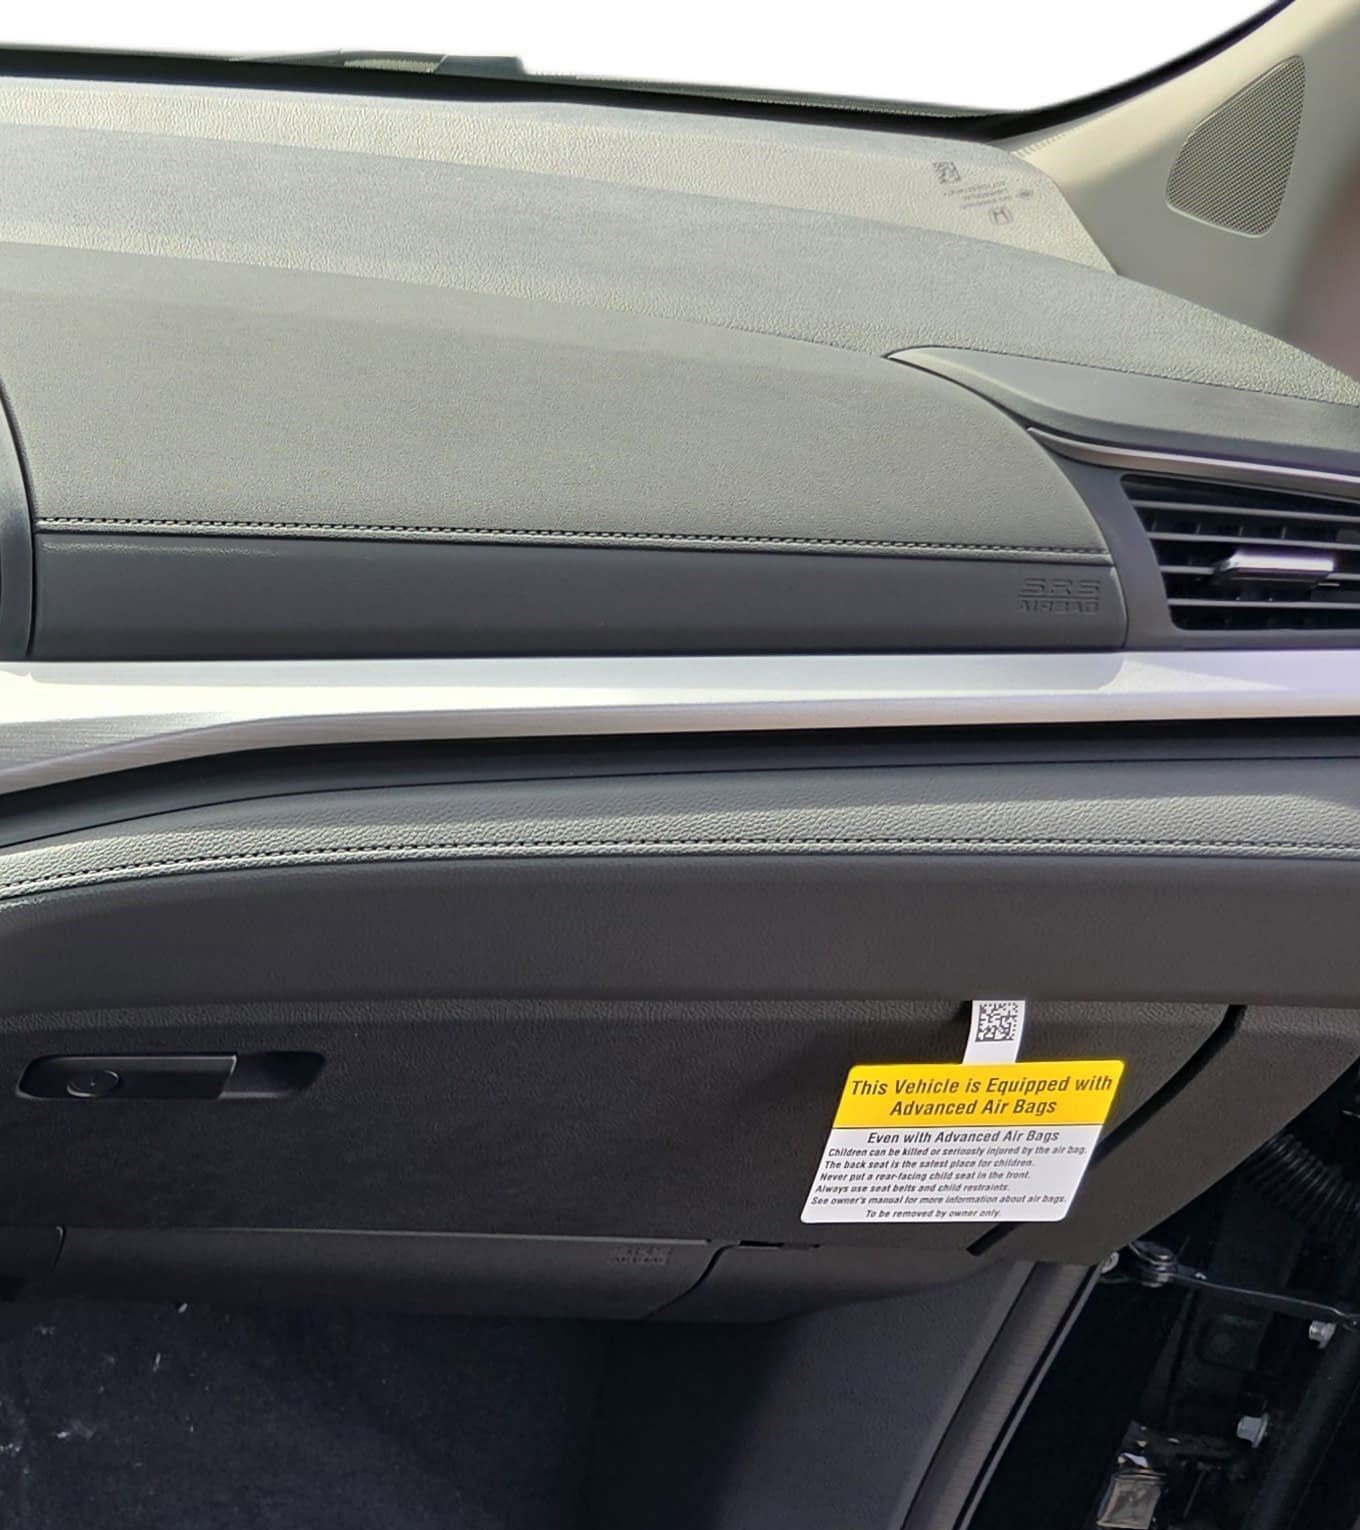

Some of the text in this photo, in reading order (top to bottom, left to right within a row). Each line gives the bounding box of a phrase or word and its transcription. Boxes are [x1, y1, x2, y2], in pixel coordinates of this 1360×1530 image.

[1020, 578, 1101, 595] SRS
[852, 1075, 1113, 1096] This Vehicle is Equipped with
[889, 1099, 1057, 1116] Advanced Air Bags
[867, 1130, 1060, 1143] Even with Advanced Air Bags
[825, 1160, 841, 1169] The
[844, 1160, 865, 1168] back
[868, 1160, 888, 1168] seat
[891, 1160, 900, 1168] is
[902, 1160, 917, 1168] the
[920, 1160, 948, 1168] safest
[950, 1160, 976, 1169] place
[978, 1160, 992, 1168] for
[816, 1185, 848, 1194] Always
[893, 1184, 916, 1192] belts
[918, 1184, 935, 1192] and
[938, 1184, 961, 1192] child
[866, 1210, 876, 1218] To
[879, 1210, 890, 1218] be
[892, 1209, 933, 1218] removed
[935, 1209, 946, 1219] by
